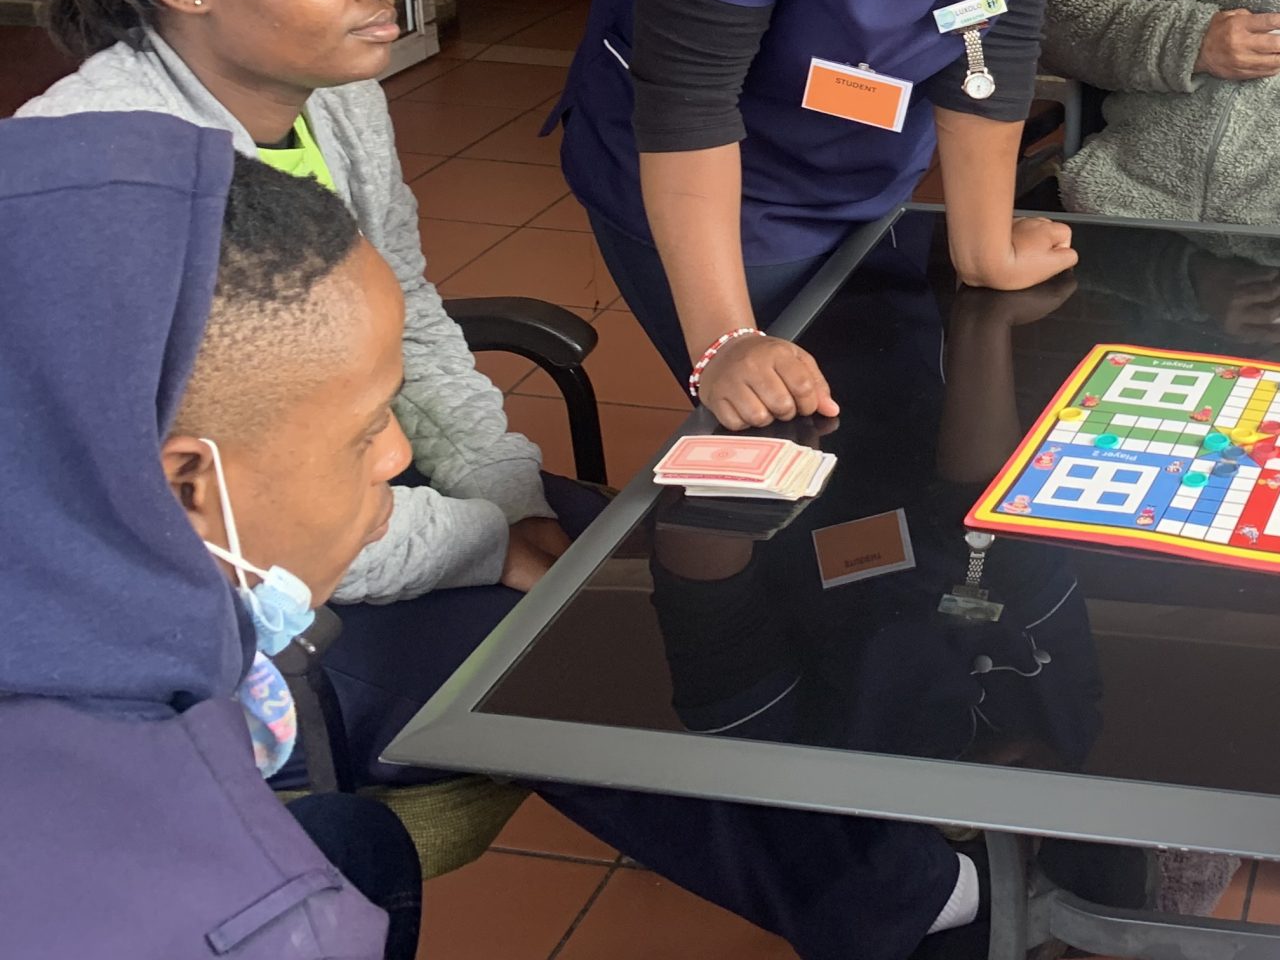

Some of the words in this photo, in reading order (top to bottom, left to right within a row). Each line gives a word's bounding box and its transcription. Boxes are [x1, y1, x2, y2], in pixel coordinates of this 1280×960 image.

[835, 77, 878, 94] STUDENT
[1161, 360, 1194, 369] Player
[1101, 452, 1138, 462] Player
